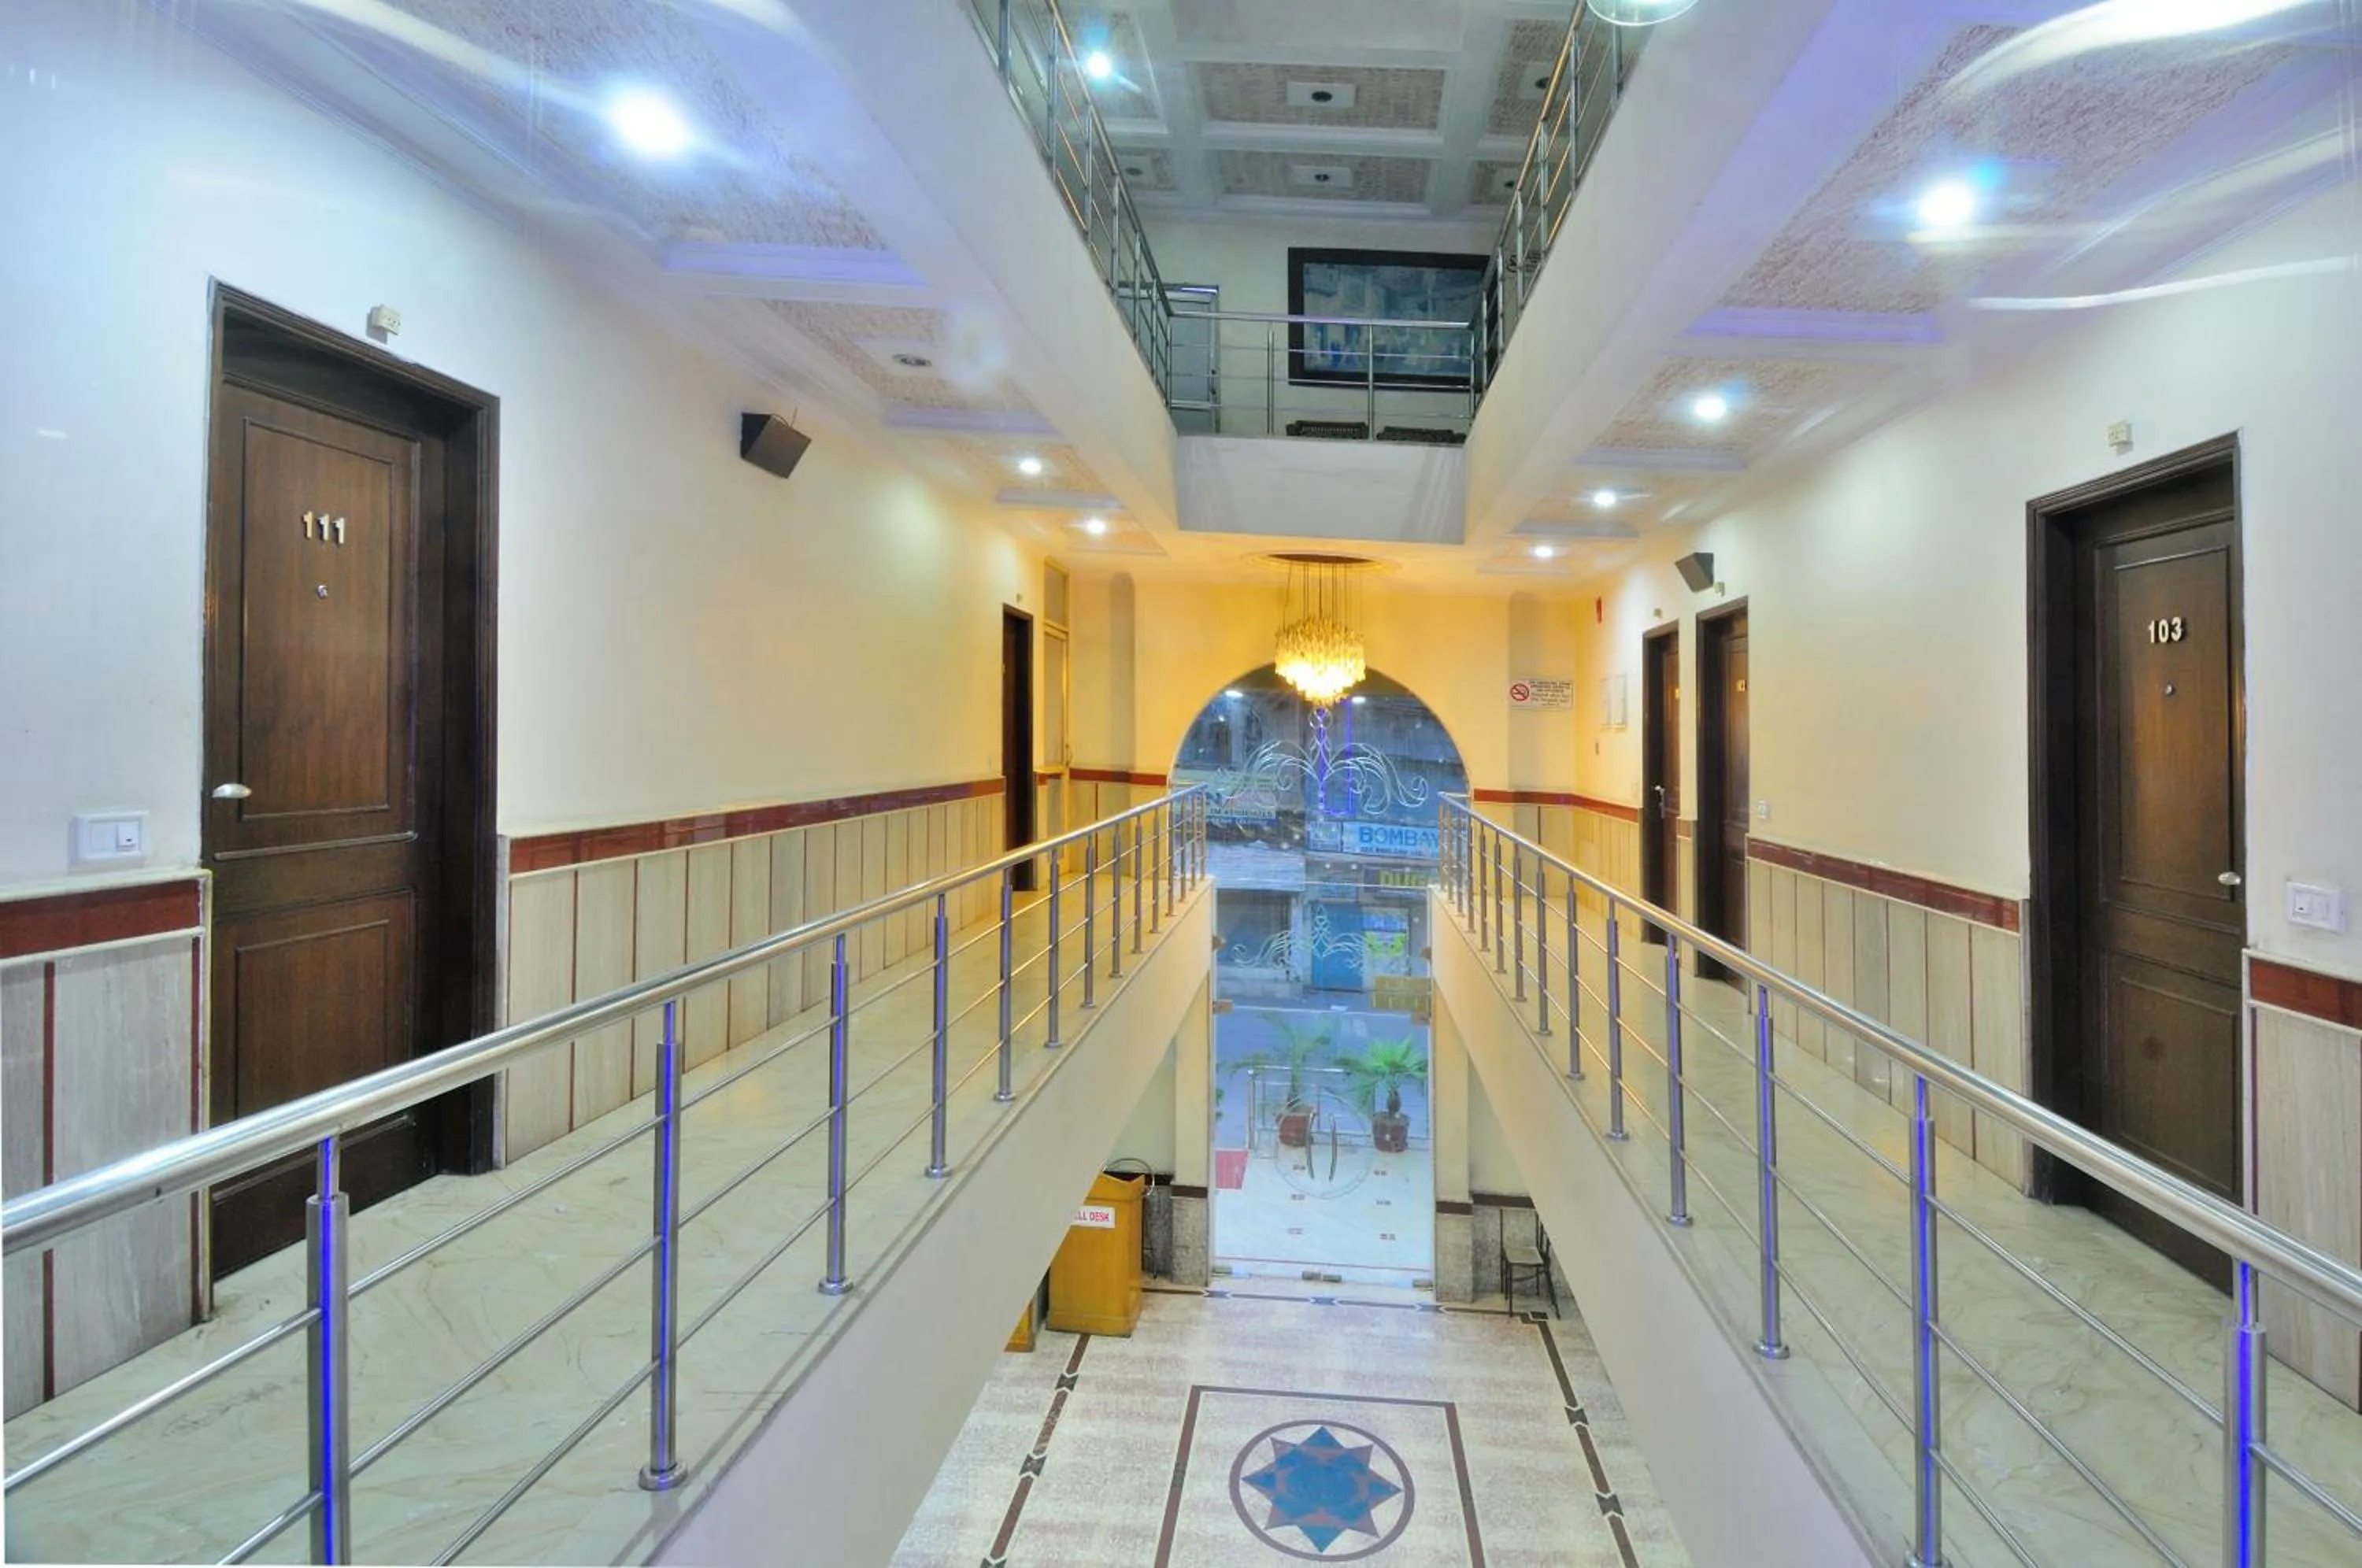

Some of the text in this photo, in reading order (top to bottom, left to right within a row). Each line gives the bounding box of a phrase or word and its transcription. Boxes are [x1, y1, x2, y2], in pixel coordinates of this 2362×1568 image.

[302, 511, 345, 545] 111
[2148, 616, 2182, 643] 103
[1089, 1211, 1109, 1222] DESK
